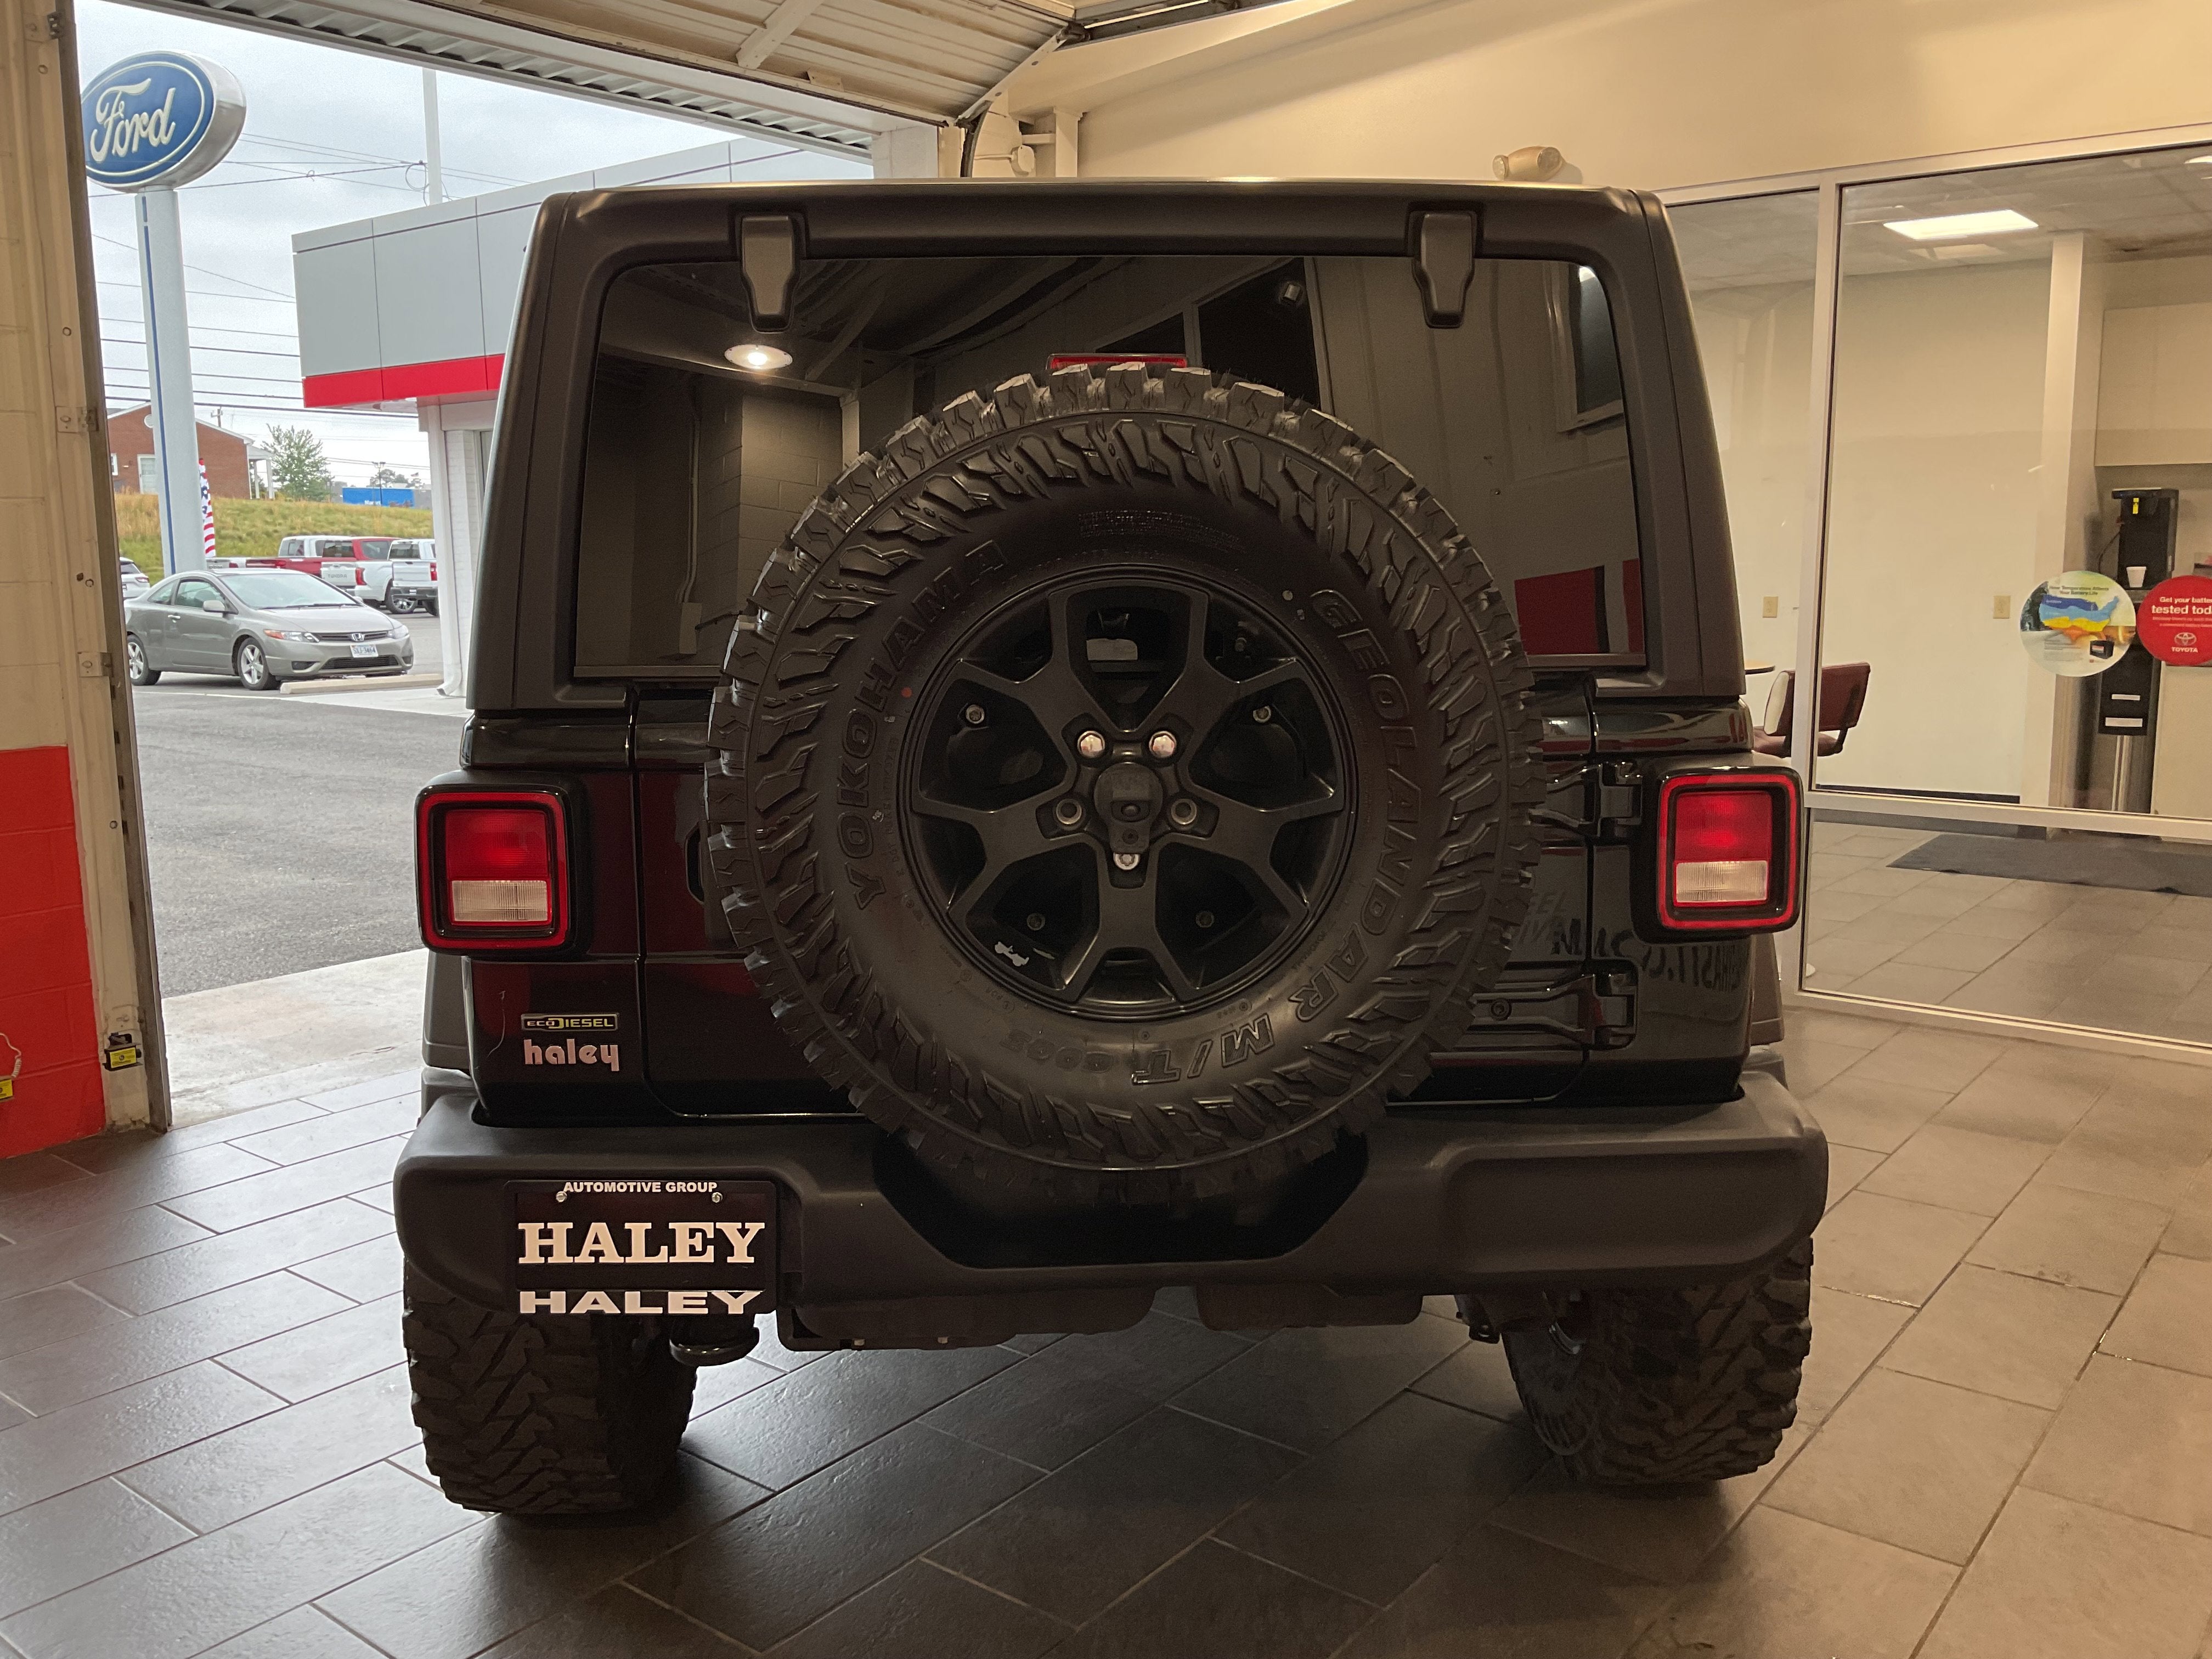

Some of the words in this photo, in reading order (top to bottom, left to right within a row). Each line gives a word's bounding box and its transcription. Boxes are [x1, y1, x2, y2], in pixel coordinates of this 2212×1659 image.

[90, 78, 176, 163] Ford
[2152, 605, 2189, 614] tested
[2192, 605, 2212, 614] tod
[837, 539, 1008, 910] YOKOHAMA
[1288, 588, 1421, 1022] GEOLANDAR
[527, 1017, 615, 1029] ECODIESEL
[523, 1038, 620, 1072] haley
[1131, 1013, 1274, 1085] M/T
[563, 1181, 661, 1193] AUTOMOTIVE
[665, 1181, 718, 1193] GROUP
[517, 1222, 766, 1264] HALEY
[519, 1290, 762, 1315] HALEY
